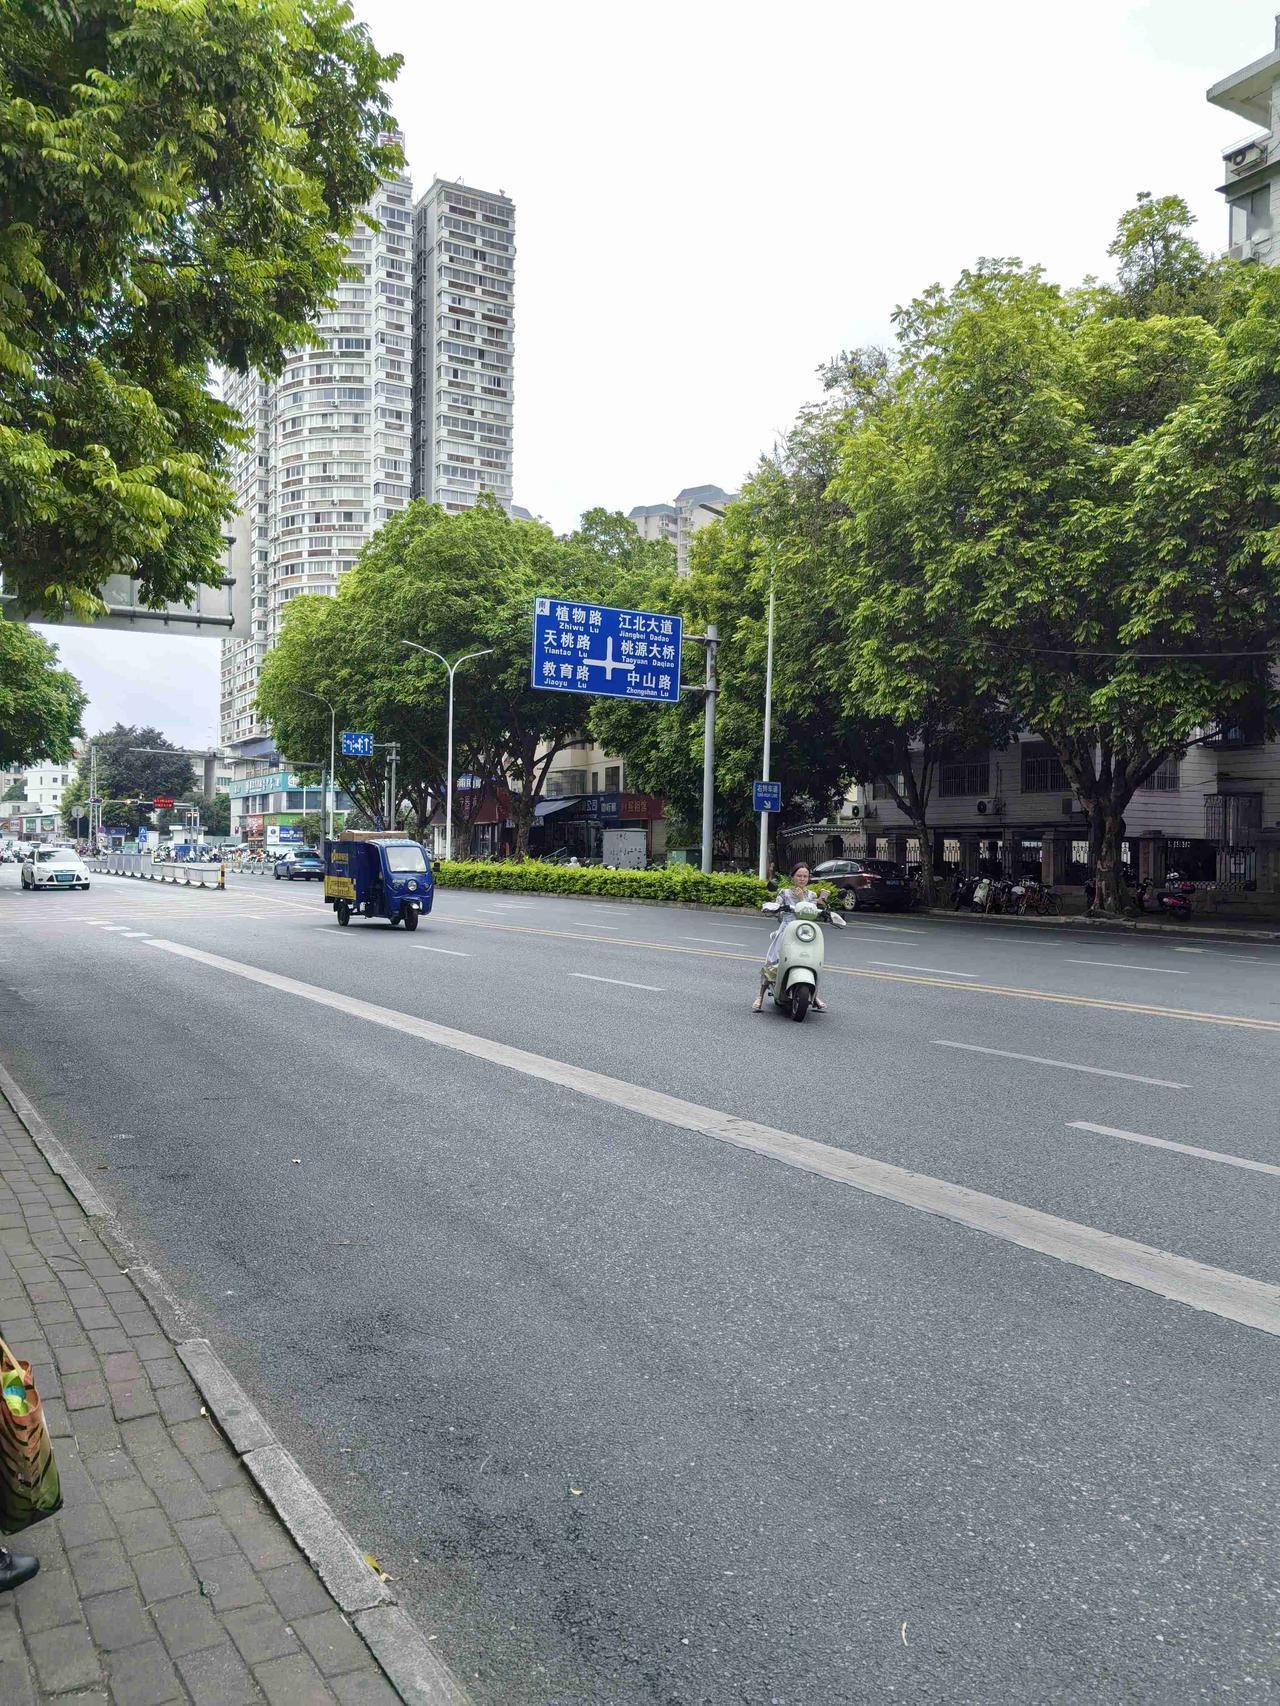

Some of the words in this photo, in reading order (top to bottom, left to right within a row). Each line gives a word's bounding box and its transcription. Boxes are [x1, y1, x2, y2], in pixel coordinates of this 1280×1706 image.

[556, 605, 602, 626] 植物路
[559, 622, 584, 632] Zhiwu
[590, 626, 599, 634] Lu
[619, 614, 673, 635] 江北大道
[544, 629, 591, 650] 天桃路
[619, 631, 646, 640] Jiangbei
[650, 634, 670, 642] Dadao
[544, 646, 572, 656] Tiantao
[578, 650, 588, 658] Lu
[621, 640, 675, 660] 桃源大桥
[622, 655, 648, 665] Taoyuan
[652, 659, 675, 668] Daqiao
[543, 661, 590, 681] 教育路
[544, 678, 568, 688] Jiaoyu
[627, 671, 671, 690] 中山路
[626, 686, 658, 696] Zhongshan
